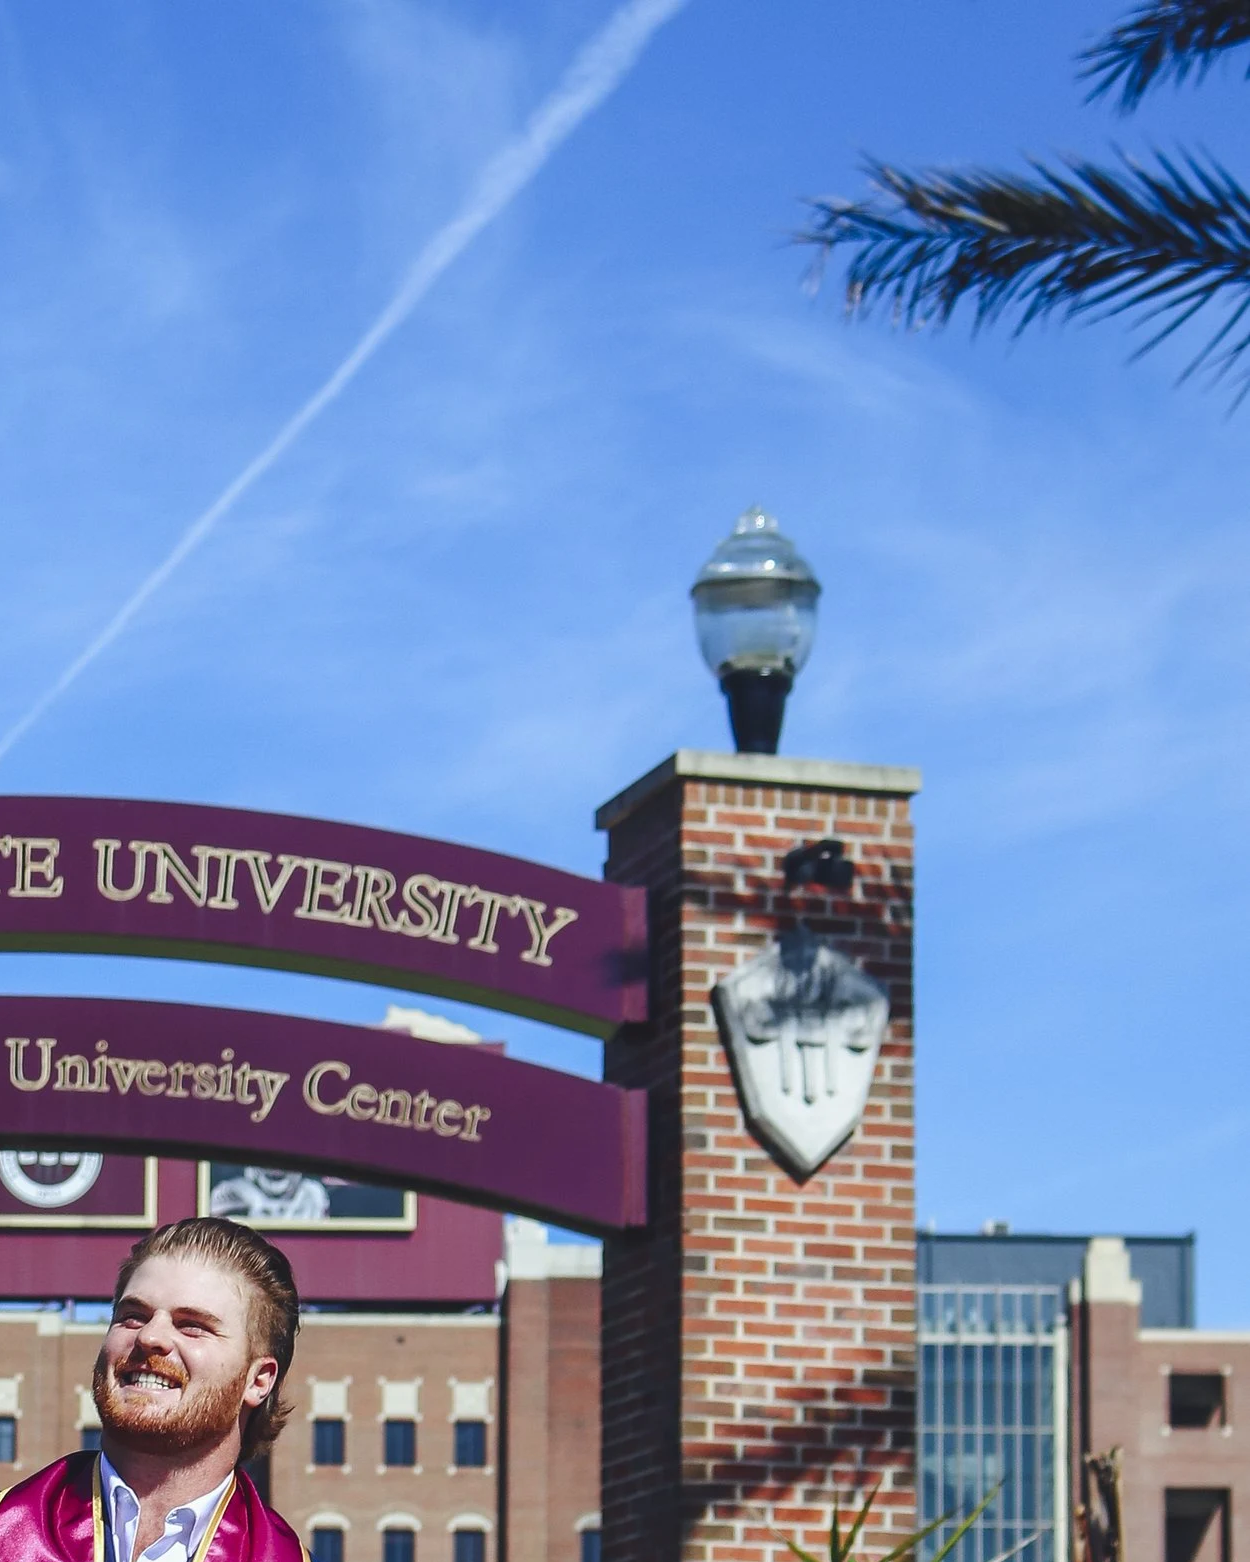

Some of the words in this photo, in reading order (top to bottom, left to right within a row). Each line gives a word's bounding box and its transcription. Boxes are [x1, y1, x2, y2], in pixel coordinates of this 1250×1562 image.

[92, 838, 578, 967] UNIVERSITY
[5, 1037, 290, 1122] University
[302, 1060, 492, 1142] Center
